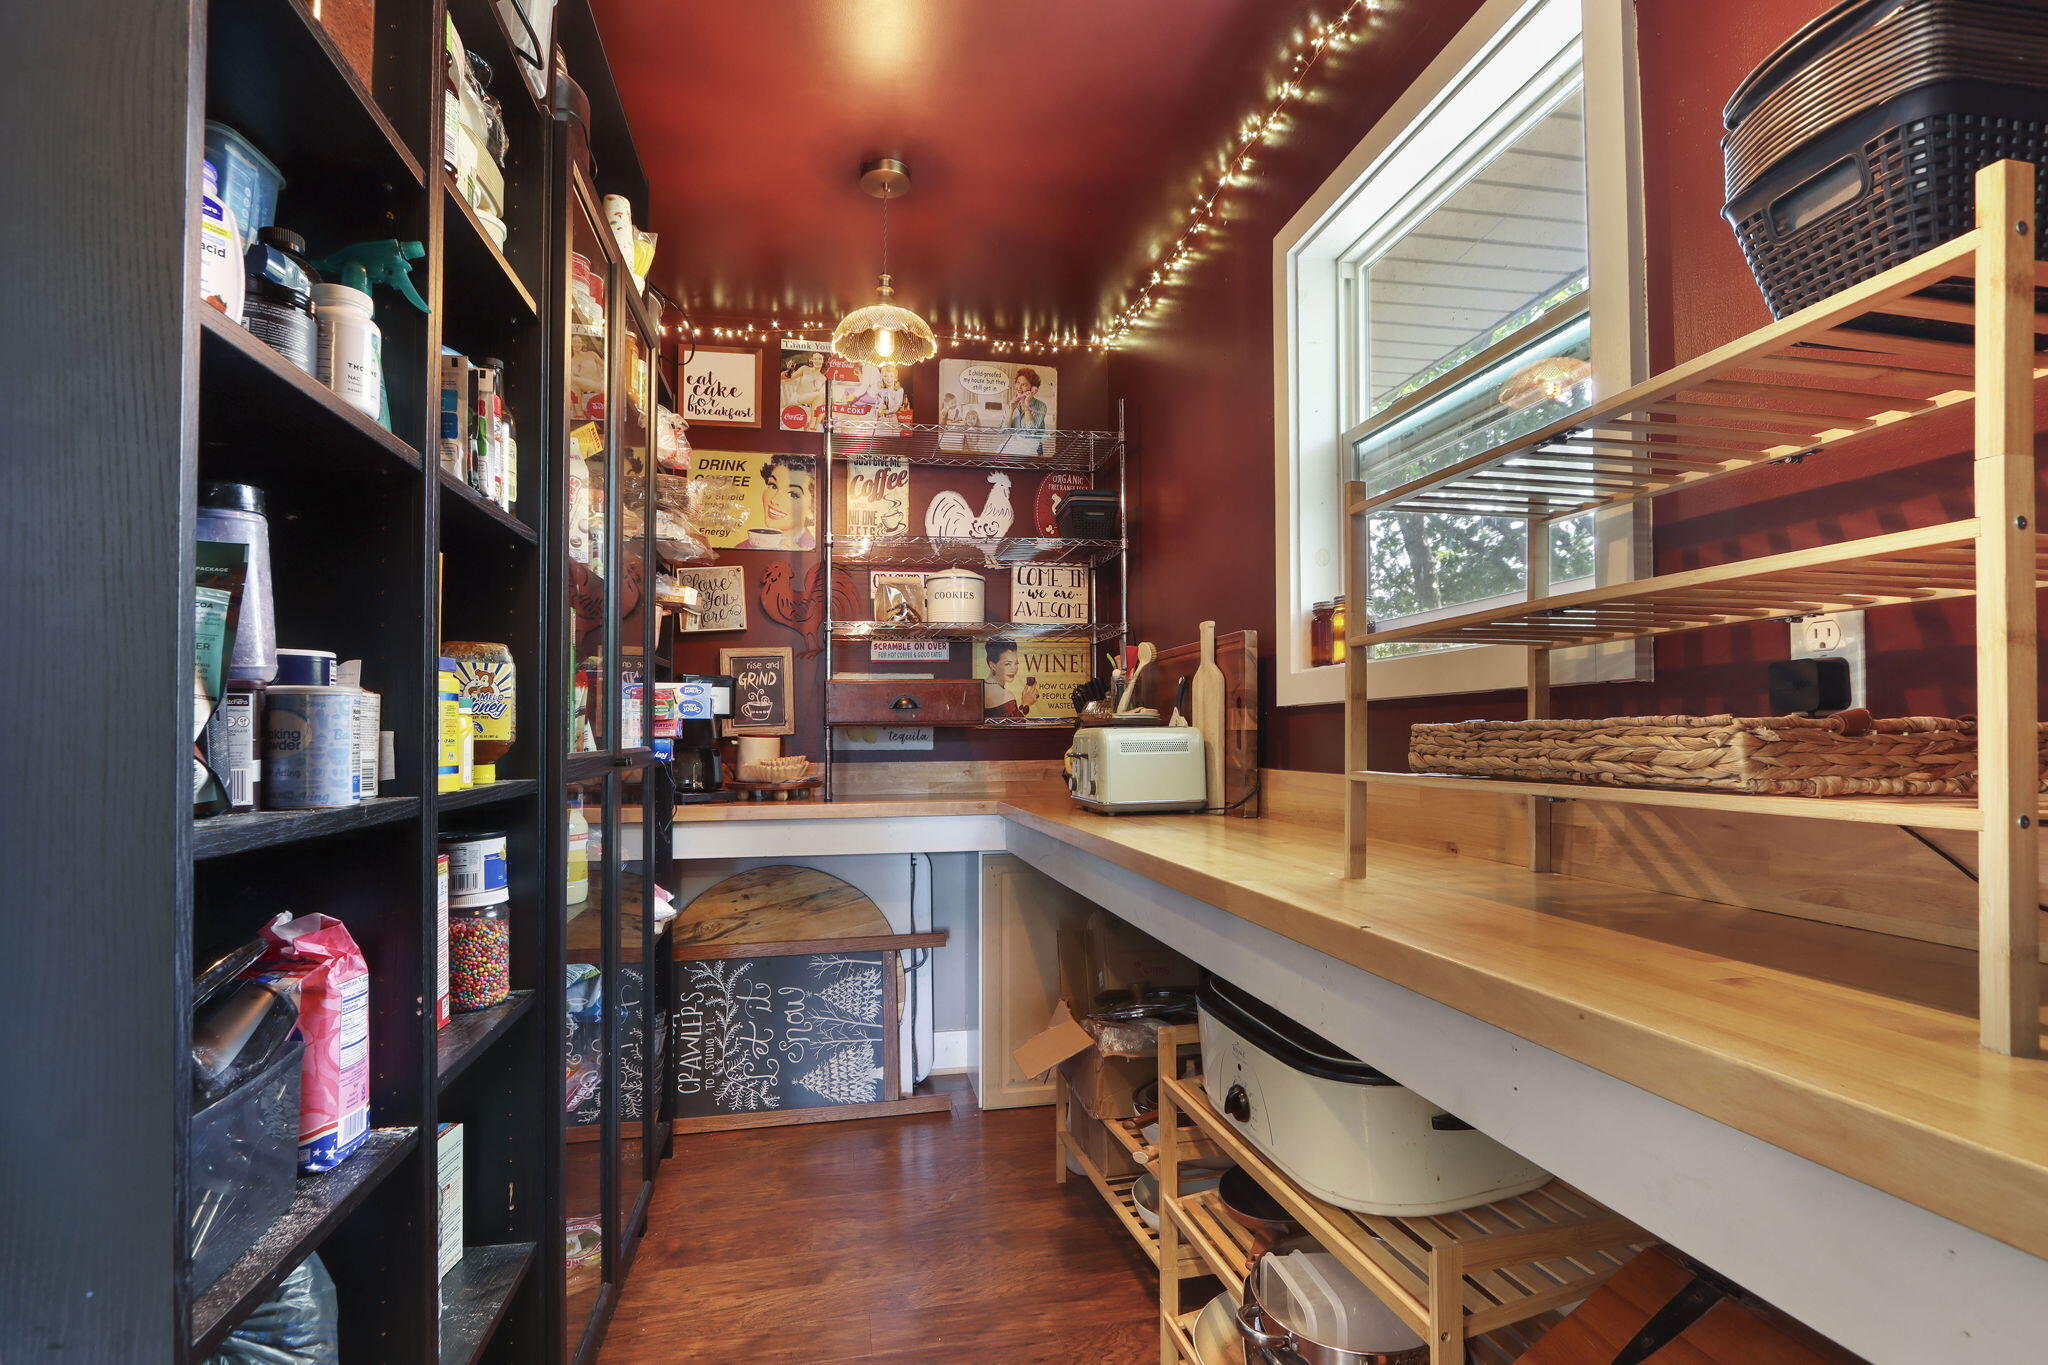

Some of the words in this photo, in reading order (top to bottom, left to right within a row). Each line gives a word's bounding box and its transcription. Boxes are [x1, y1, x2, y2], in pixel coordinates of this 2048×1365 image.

[815, 342, 832, 351] You
[686, 371, 717, 386] eat
[692, 381, 743, 398] cake
[687, 394, 719, 412] for
[694, 402, 753, 420] breakfast
[698, 458, 748, 472] DRINK
[850, 467, 908, 502] Coffee
[1052, 474, 1084, 485] ORGANIC
[849, 510, 859, 525] NO
[862, 510, 877, 526] ONE
[699, 528, 731, 538] Energy
[1017, 565, 1063, 588] COME
[1067, 569, 1086, 588] IN
[934, 591, 975, 600] COOKIES
[1027, 588, 1047, 600] we
[1053, 589, 1075, 600] are
[700, 606, 738, 628] ore
[1013, 601, 1088, 619] AWESOME
[873, 642, 911, 650] SCRAMBLE
[914, 642, 925, 650] ON
[927, 642, 947, 650] OVER
[746, 661, 761, 669] rise
[765, 661, 780, 670] and
[1024, 653, 1084, 673] WINE!
[1042, 692, 1066, 700] PEOPLE
[472, 697, 508, 717] oney
[1047, 702, 1075, 710] WASTED
[887, 729, 929, 745] tequila
[735, 978, 773, 1018] it
[677, 991, 705, 1095] CRAWLERS
[705, 1038, 715, 1070] STUDIO
[737, 1020, 780, 1087] Let
[705, 1078, 715, 1091] TO
